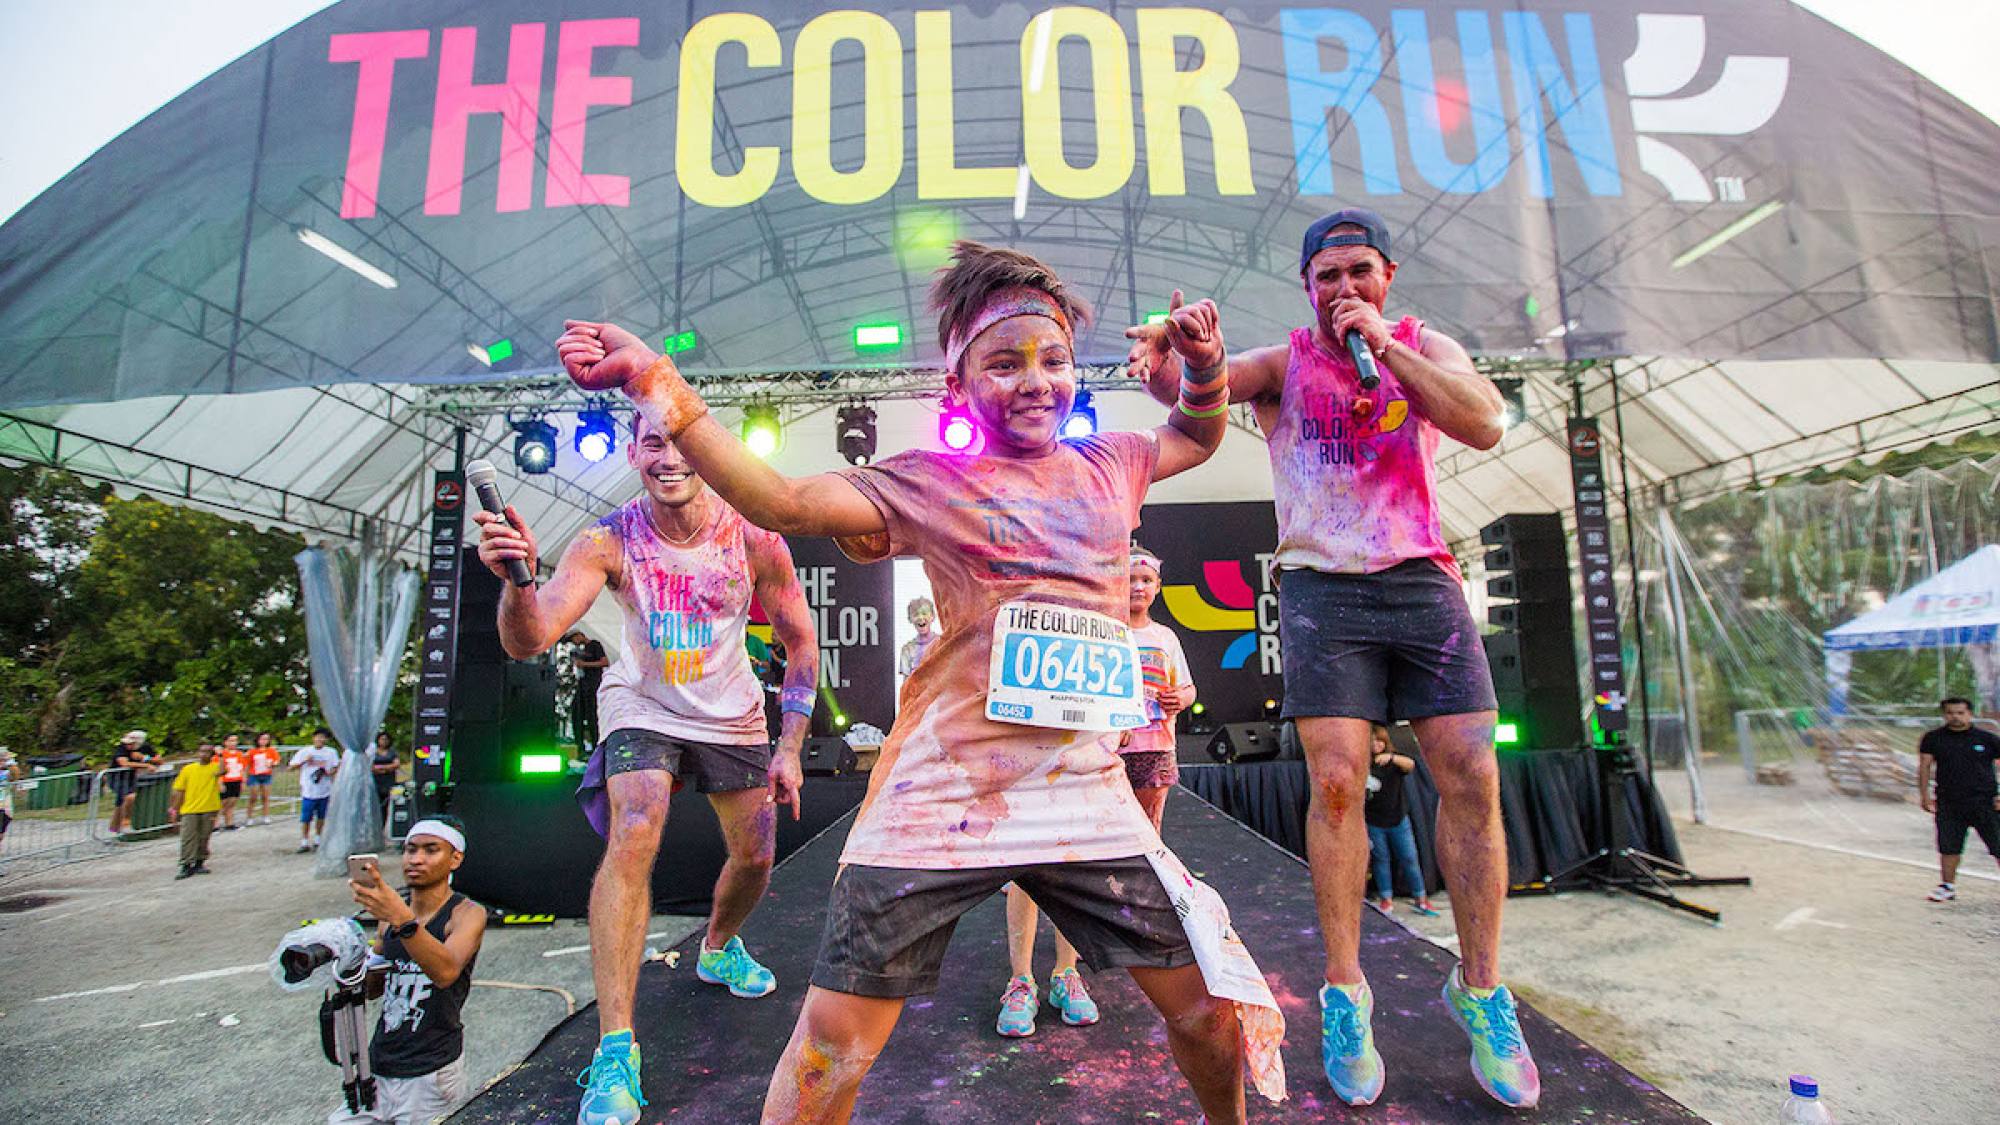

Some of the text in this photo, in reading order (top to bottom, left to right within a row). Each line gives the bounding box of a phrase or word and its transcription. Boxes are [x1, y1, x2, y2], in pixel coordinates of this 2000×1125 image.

[329, 18, 640, 218] THE
[675, 6, 1256, 207] COLOR
[1279, 8, 1623, 200] RUN
[1302, 417, 1355, 440] COLOR
[1320, 442, 1355, 465] RUN
[655, 569, 695, 612] THE
[798, 566, 836, 606] HE
[649, 610, 713, 651] COLOR
[811, 606, 879, 646] LOR
[1009, 608, 1114, 640] THE COLOR RUN
[664, 649, 707, 686] RUN
[1014, 637, 1123, 695] 06452
